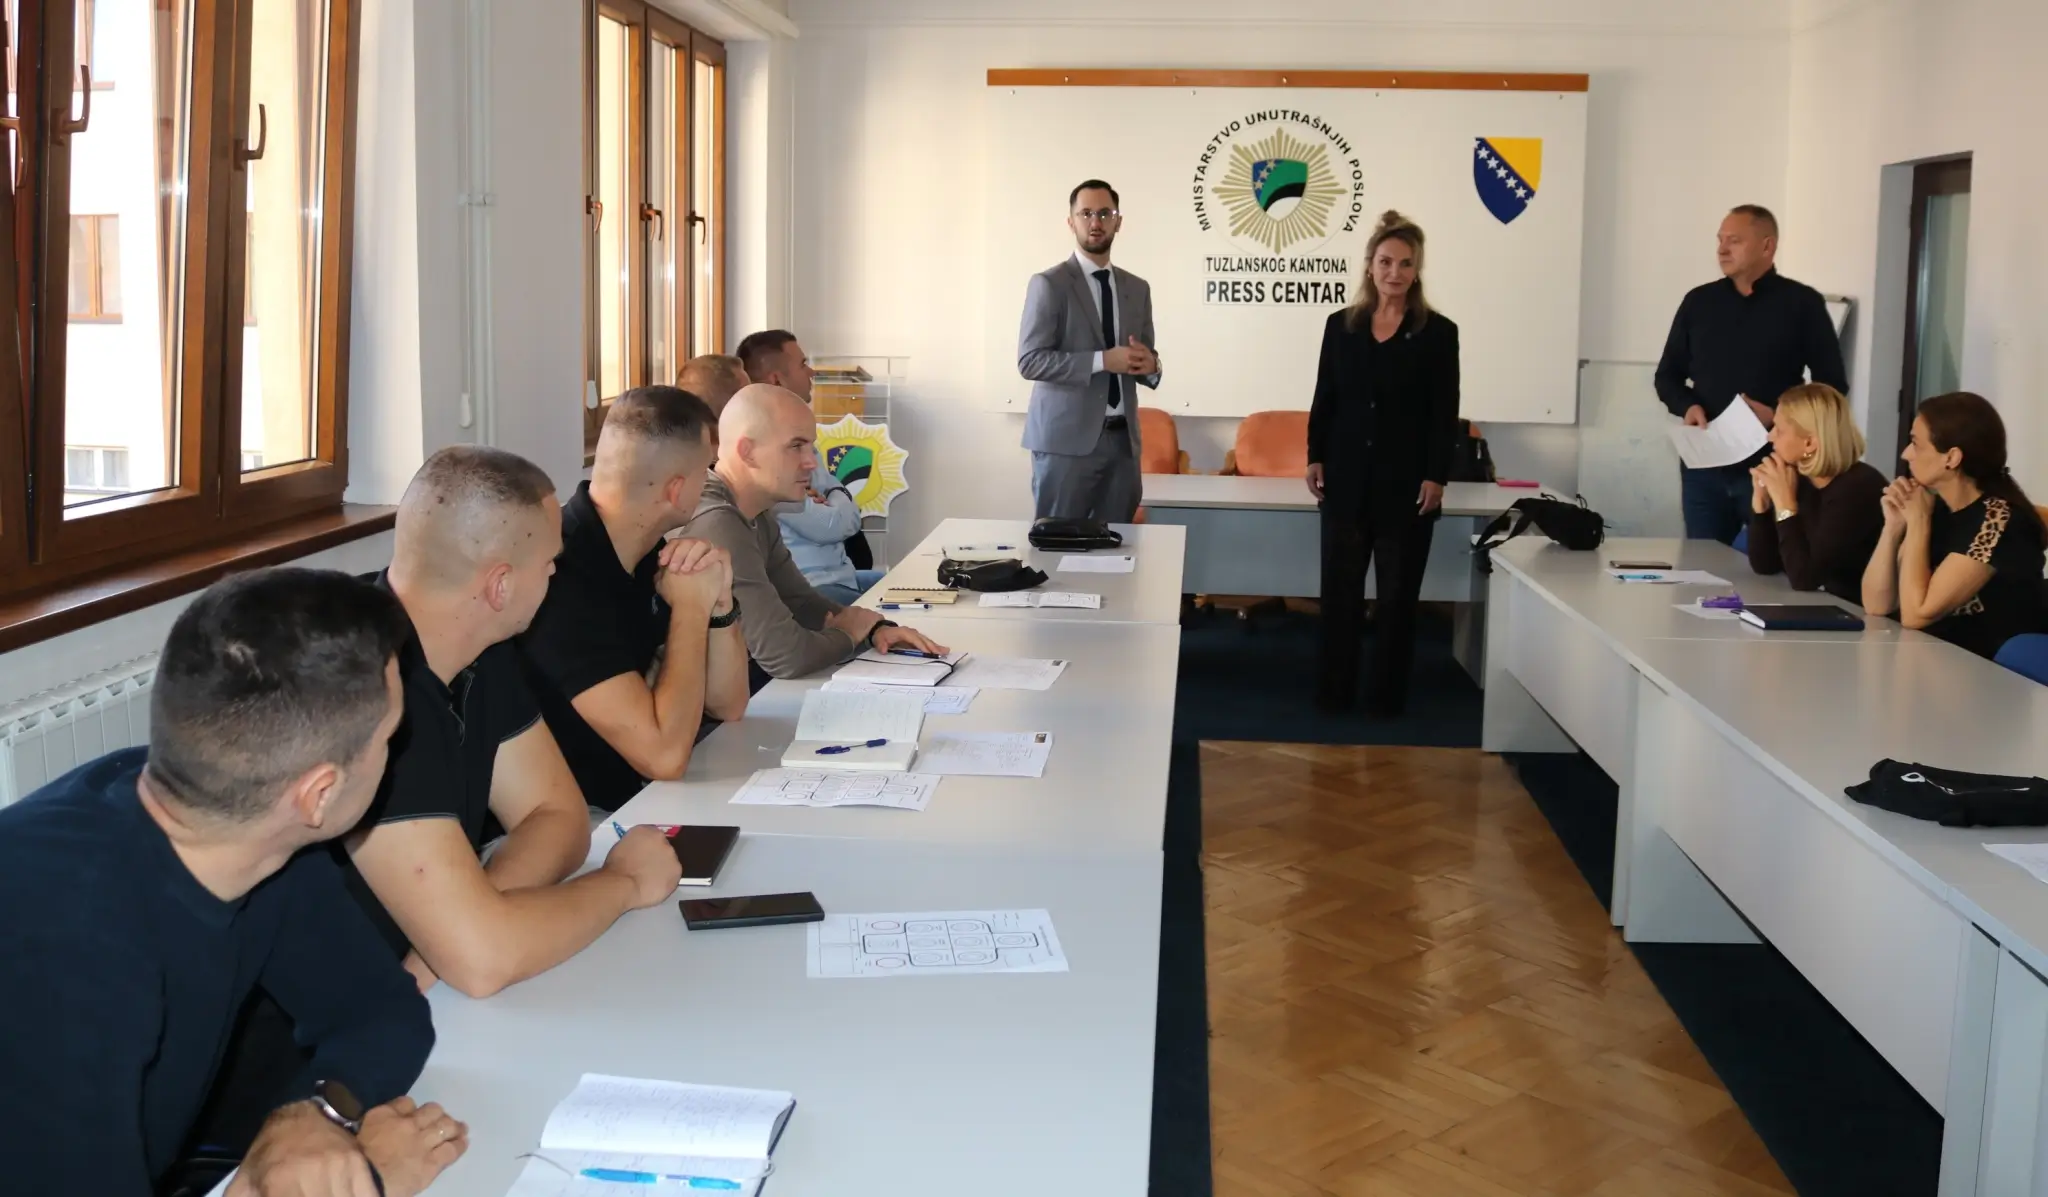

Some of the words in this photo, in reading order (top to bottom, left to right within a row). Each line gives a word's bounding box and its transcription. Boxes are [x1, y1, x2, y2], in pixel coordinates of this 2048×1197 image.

[1193, 120, 1241, 232] MINISTARSTVO
[1245, 109, 1351, 155] UNUTRAŠNJIH
[1343, 158, 1364, 233] POSLOVA
[1206, 256, 1286, 273] TUZLANSKOG
[1290, 256, 1347, 273] KANTONA
[1206, 280, 1265, 304] PRESS
[1272, 281, 1346, 304] CENTAR
